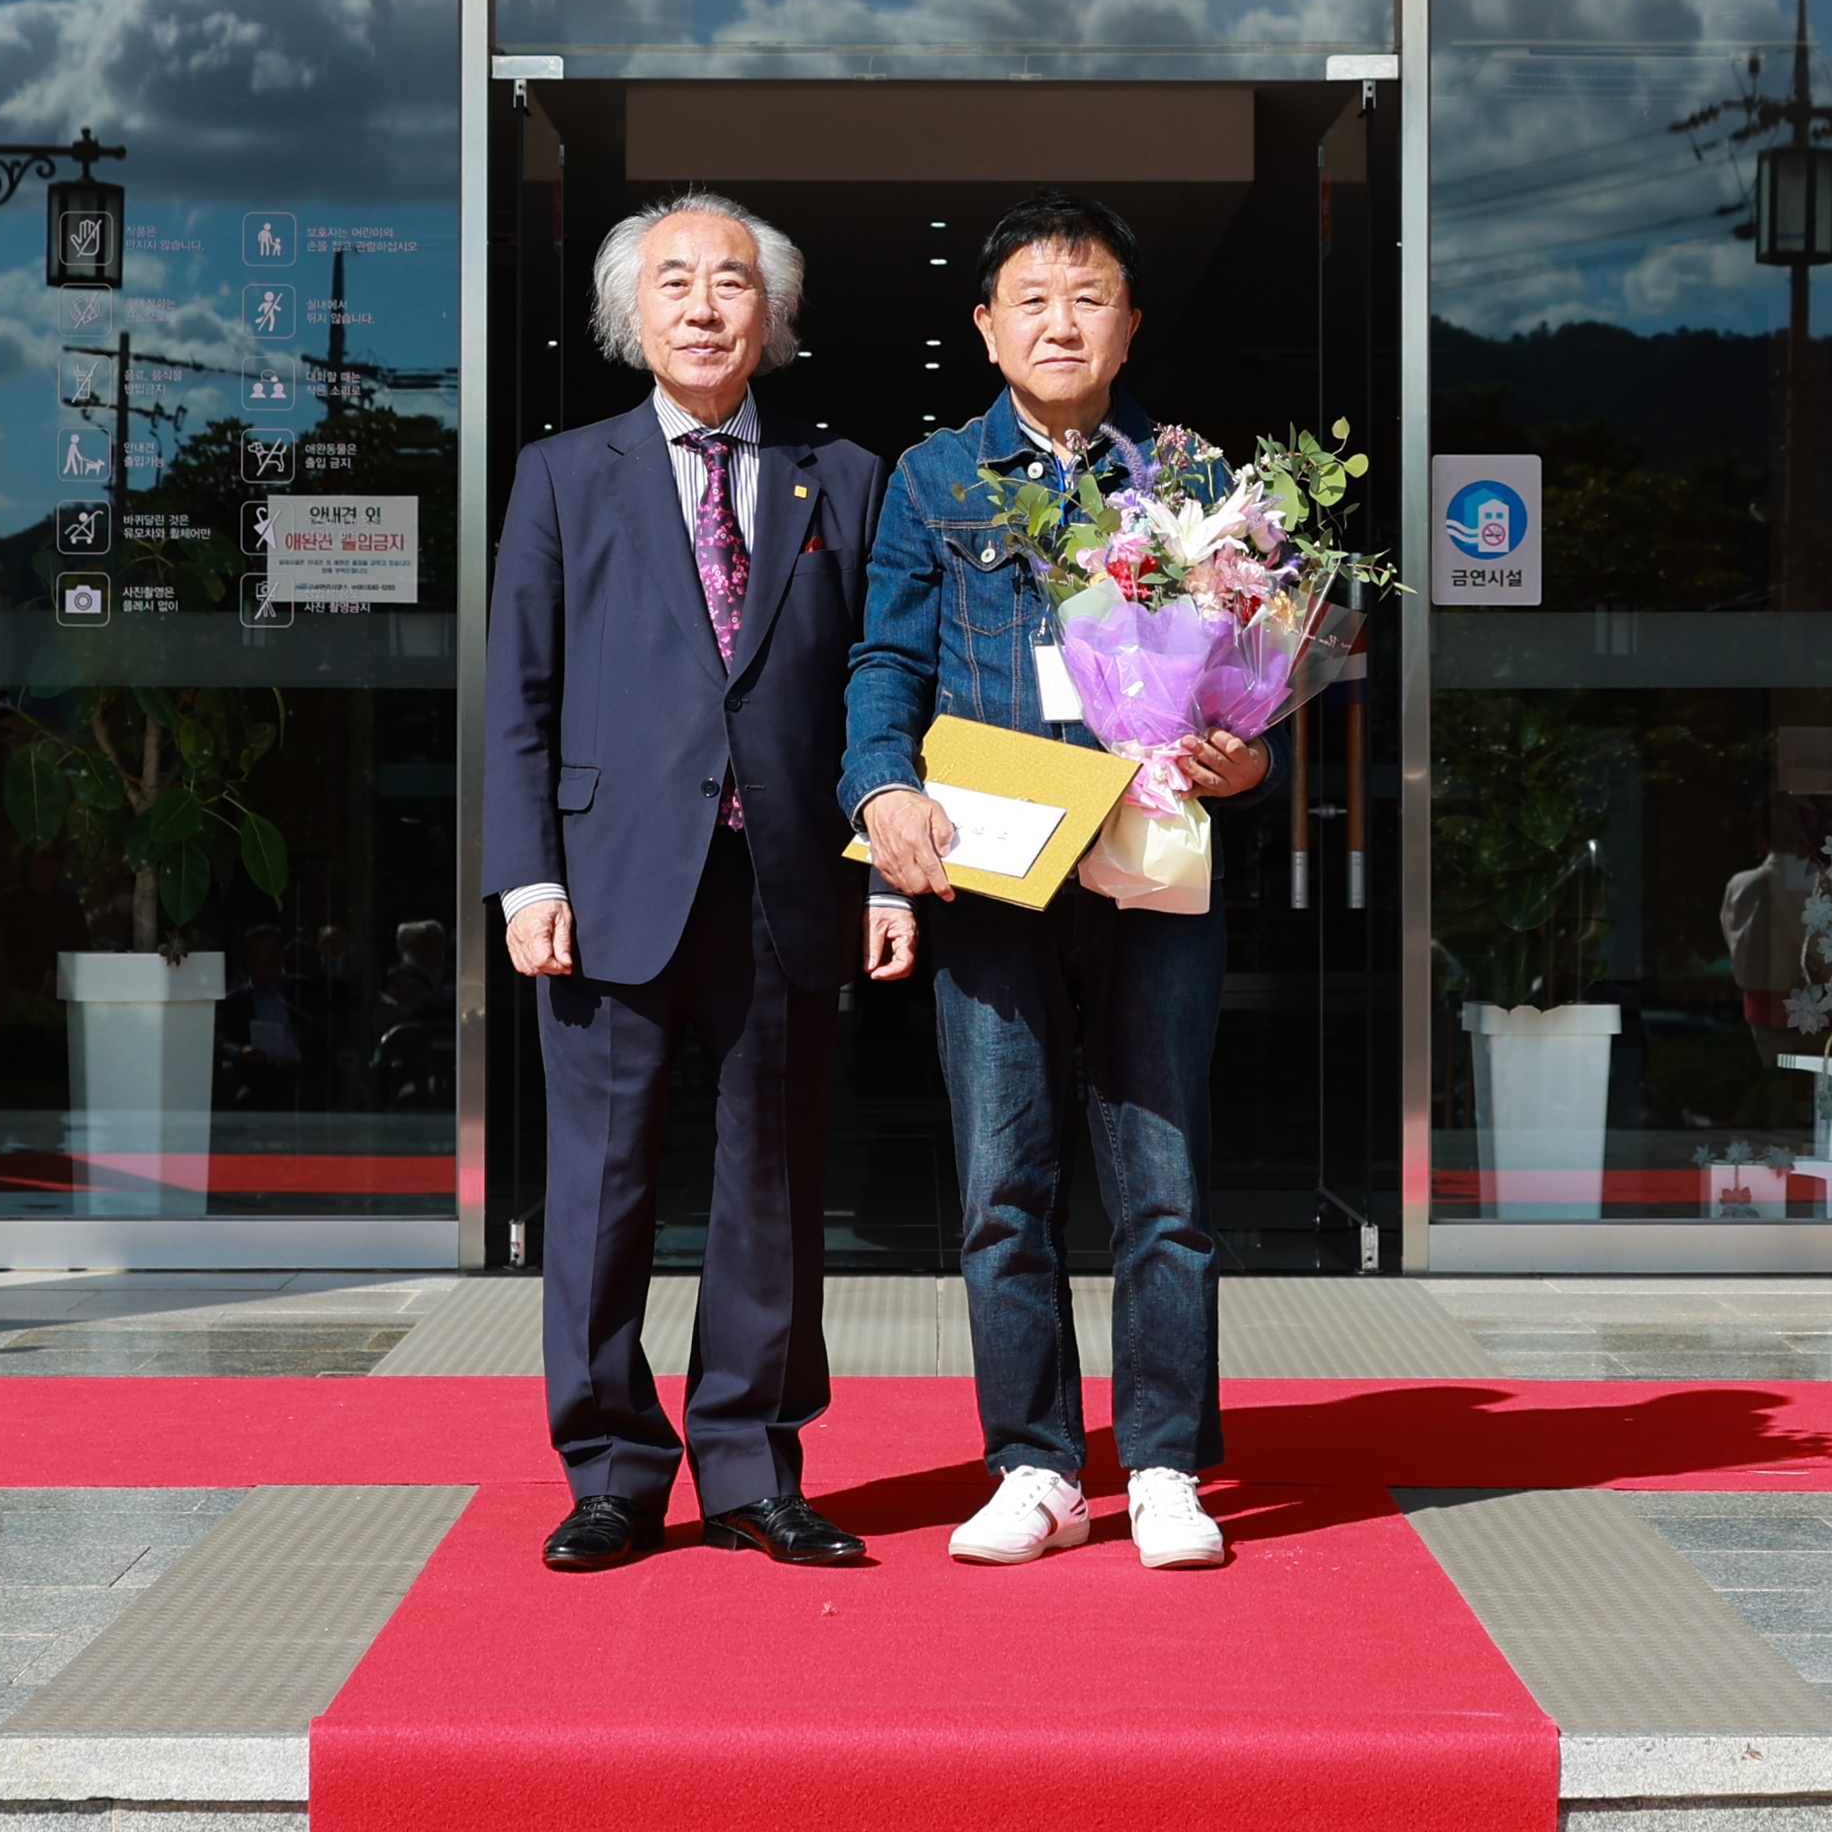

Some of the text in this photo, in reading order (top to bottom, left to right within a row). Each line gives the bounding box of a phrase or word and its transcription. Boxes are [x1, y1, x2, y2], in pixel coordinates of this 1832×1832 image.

[306, 241, 328, 252] 손을
[331, 241, 353, 252] 잡고
[306, 299, 348, 310] 실내에서
[123, 442, 155, 454] 안내견
[304, 443, 357, 455] 애완동물은
[123, 456, 165, 467] 출입가능
[304, 457, 351, 468] 출입 금지
[123, 515, 189, 526] 바퀴달린 것은
[123, 528, 211, 540] 유모차와 휠체어만
[1451, 570, 1523, 587] 금연시설
[122, 586, 175, 598] 사진촬영은
[157, 600, 179, 612] 없이
[304, 602, 325, 613] 사진
